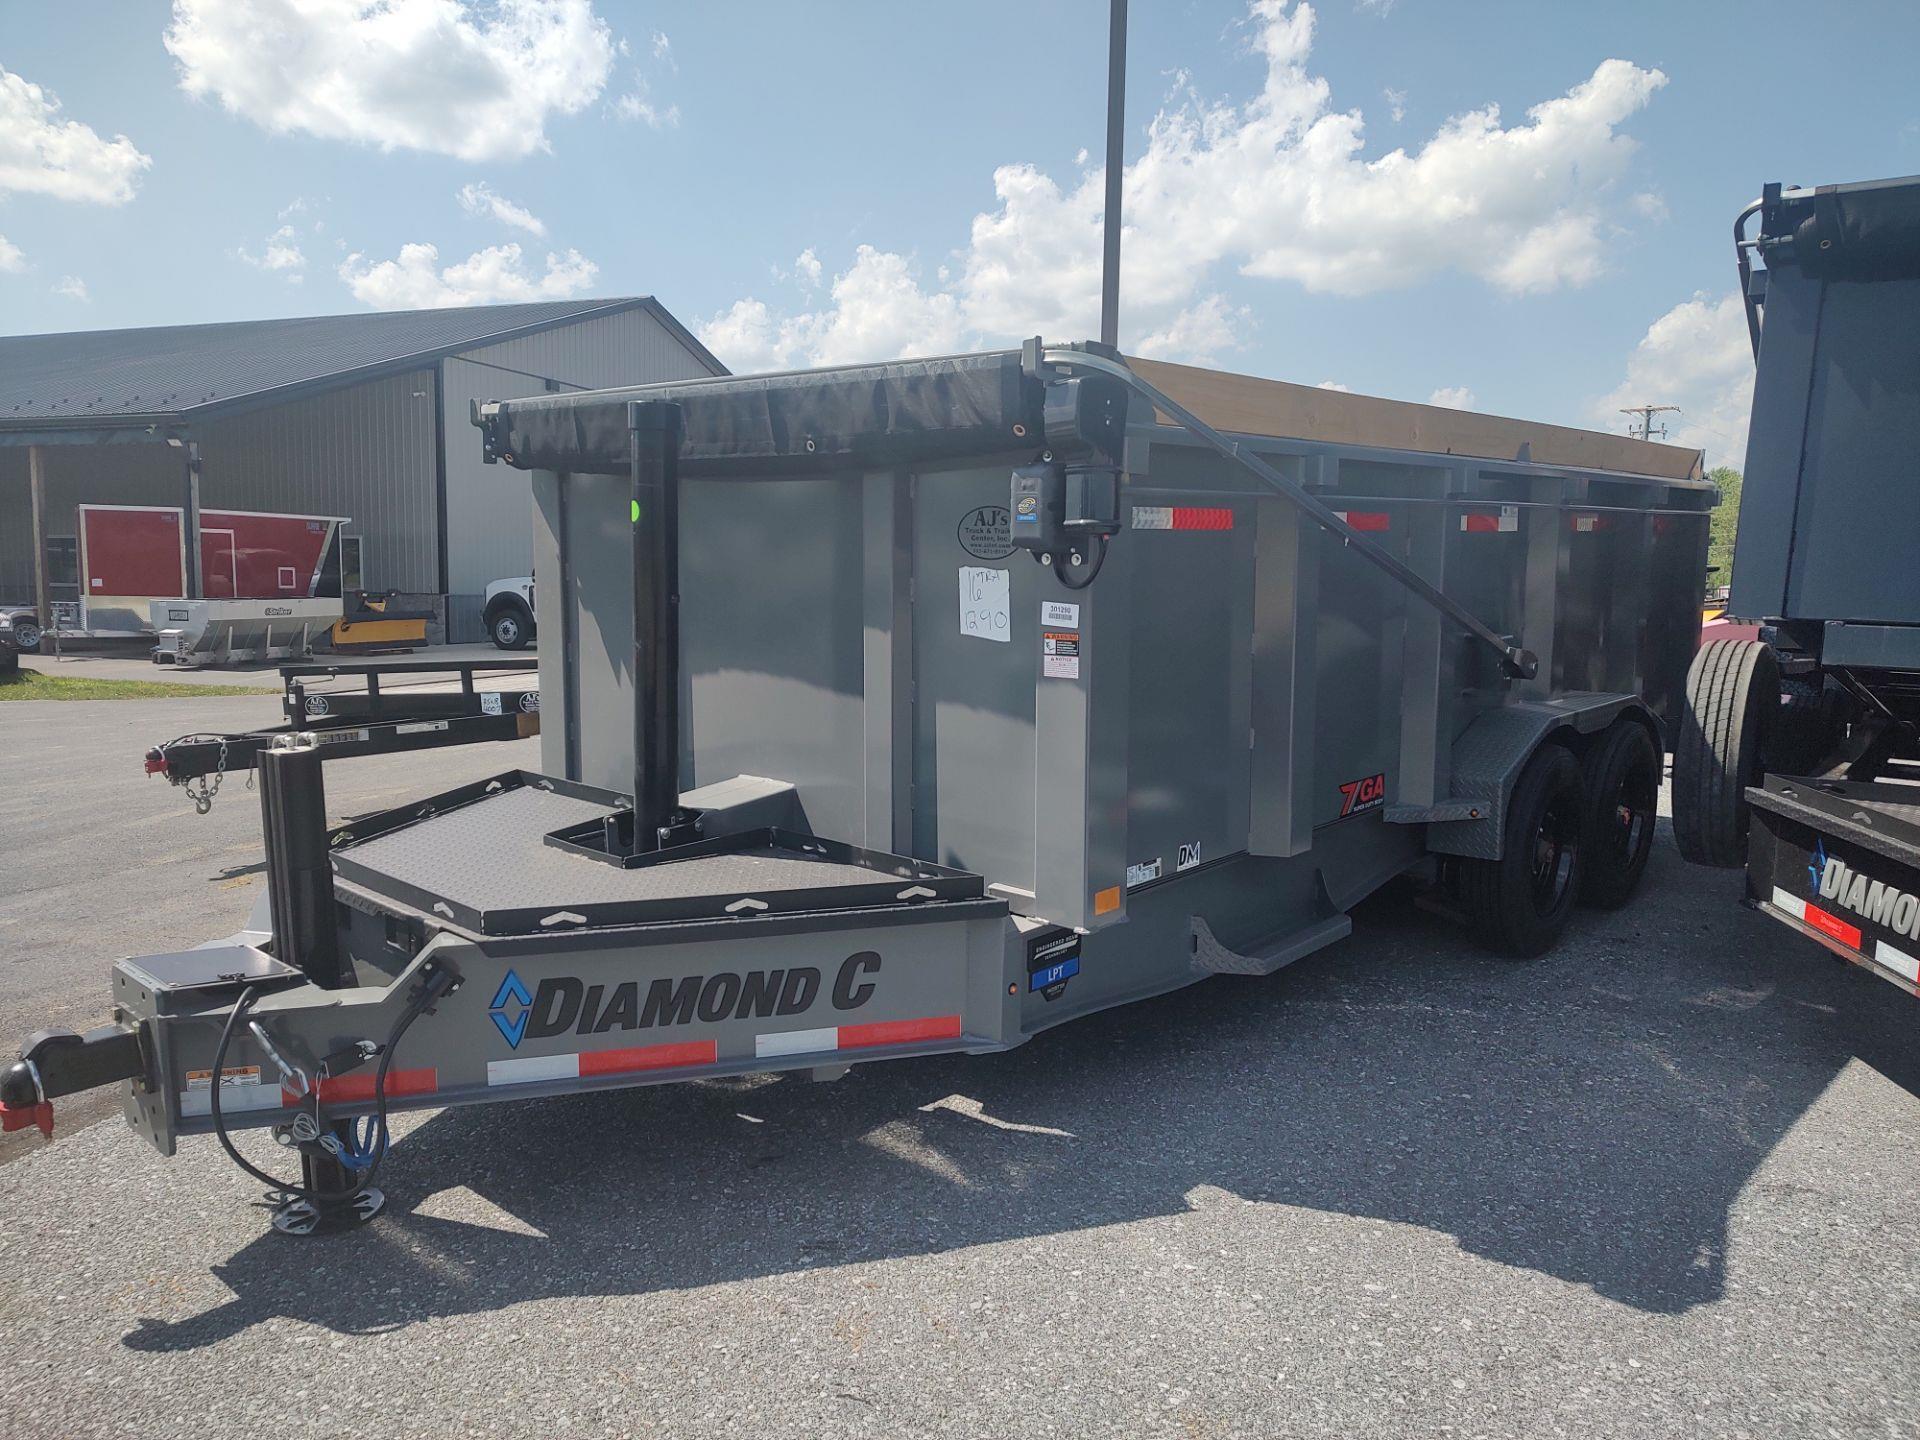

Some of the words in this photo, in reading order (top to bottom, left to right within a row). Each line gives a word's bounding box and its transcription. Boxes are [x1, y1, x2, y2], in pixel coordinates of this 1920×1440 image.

[974, 510, 1008, 526] AJ's
[1178, 841, 1200, 867] DM
[1047, 965, 1064, 982] LPT
[524, 966, 821, 1039] DIAMOND
[832, 951, 882, 1011] C
